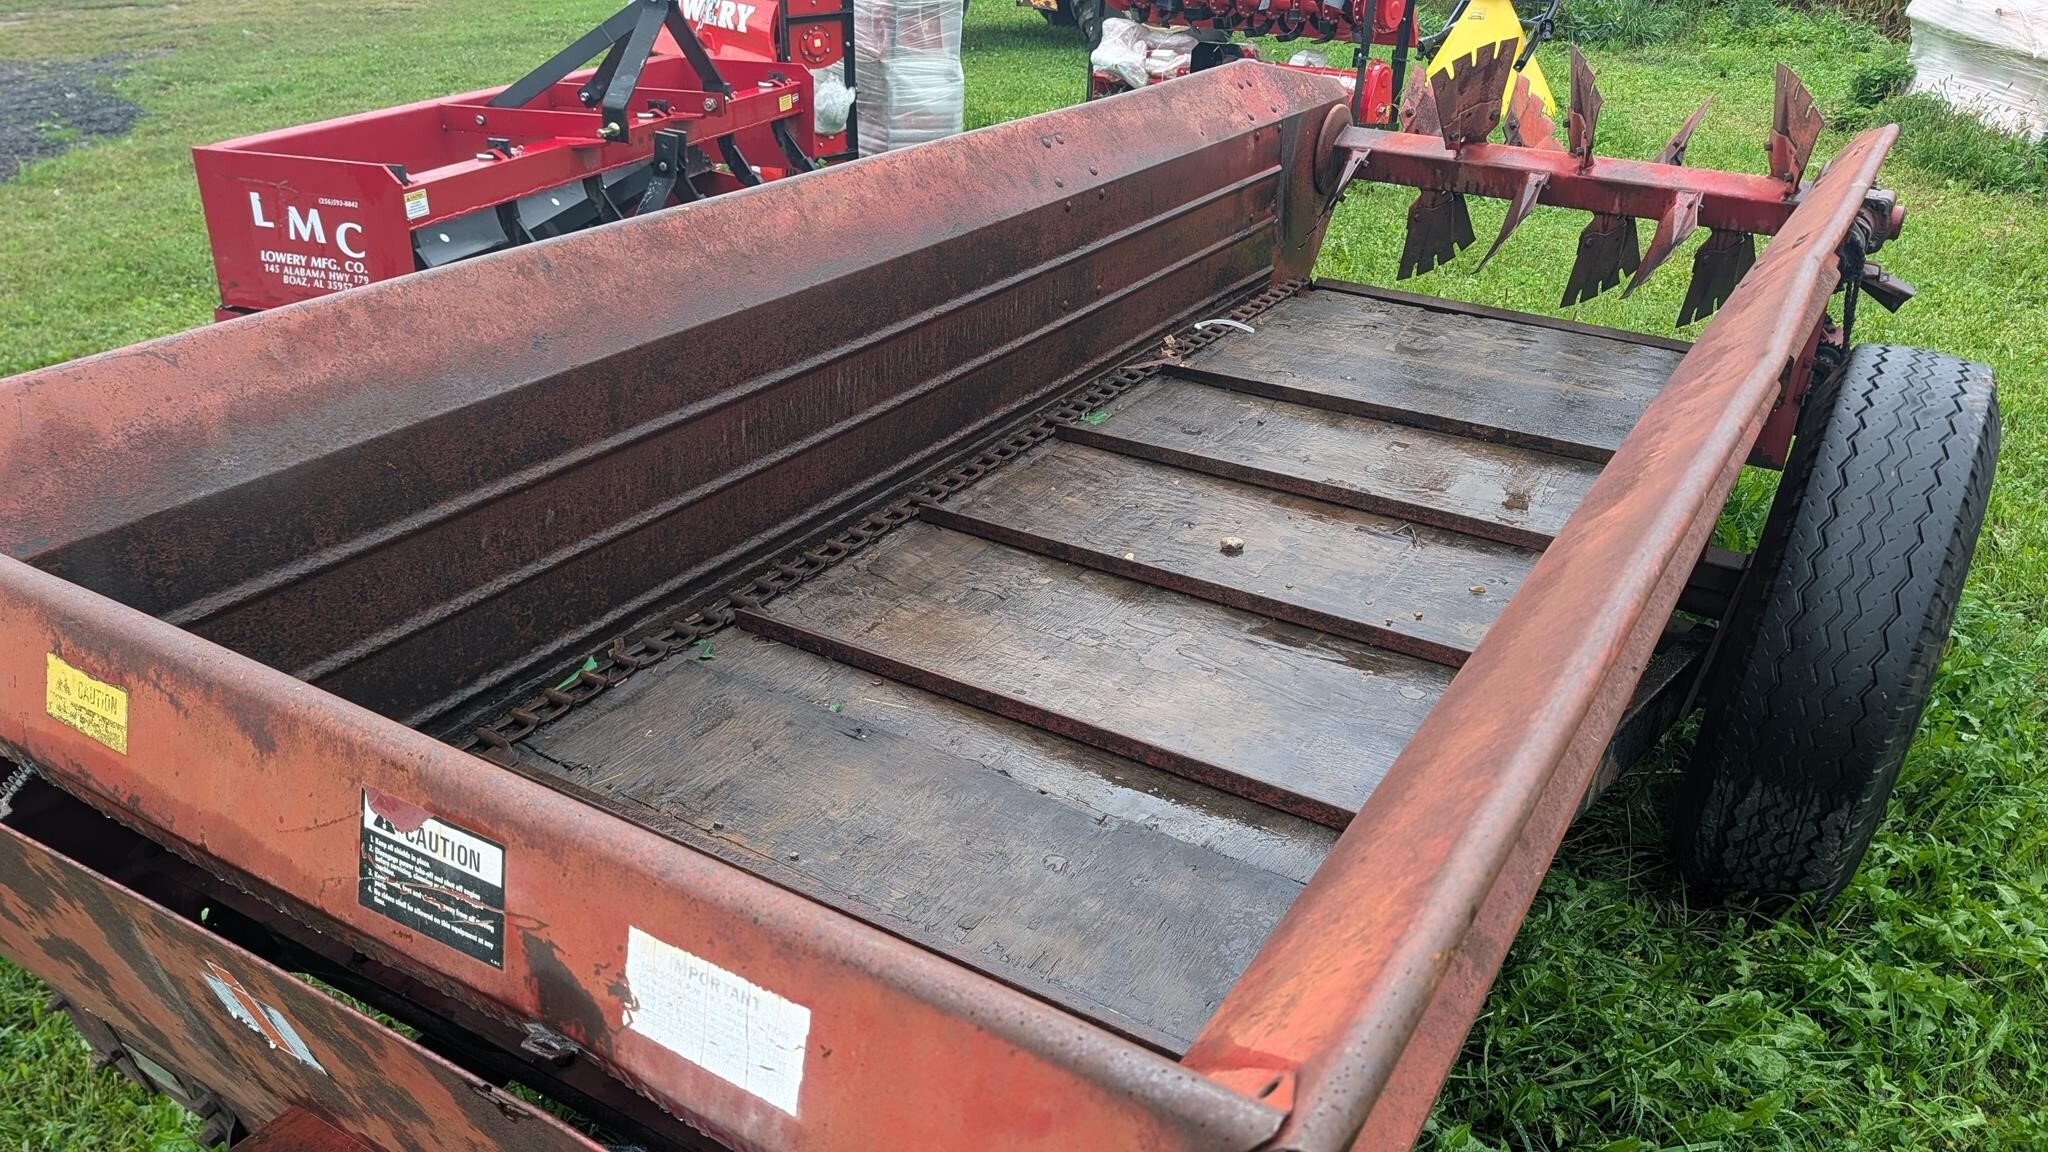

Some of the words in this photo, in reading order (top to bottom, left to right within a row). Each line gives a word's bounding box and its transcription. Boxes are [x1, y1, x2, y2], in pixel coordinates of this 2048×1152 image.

[678, 0, 756, 33] WERY
[261, 250, 307, 265] LOWERY
[310, 257, 341, 271] MFG.
[344, 261, 369, 274] CO.
[264, 263, 280, 274] 145
[283, 266, 326, 280] ALABAMA
[328, 271, 351, 283] HWY
[353, 275, 369, 285] 179
[283, 275, 311, 288] BOAZ,
[313, 281, 325, 289] AL
[77, 681, 118, 716] CAUTION
[375, 837, 387, 850] Keep
[394, 847, 410, 859] shields
[375, 854, 390, 867] before
[399, 859, 414, 870] power
[414, 865, 434, 879] take-off
[434, 875, 443, 884] and
[444, 879, 455, 889] shut
[455, 885, 463, 893] off
[381, 892, 395, 903] riders
[396, 899, 407, 909] shall
[414, 908, 433, 921] allowed
[441, 920, 450, 929] this
[451, 925, 477, 941] equipment
[484, 940, 494, 950] any
[456, 908, 468, 920] from
